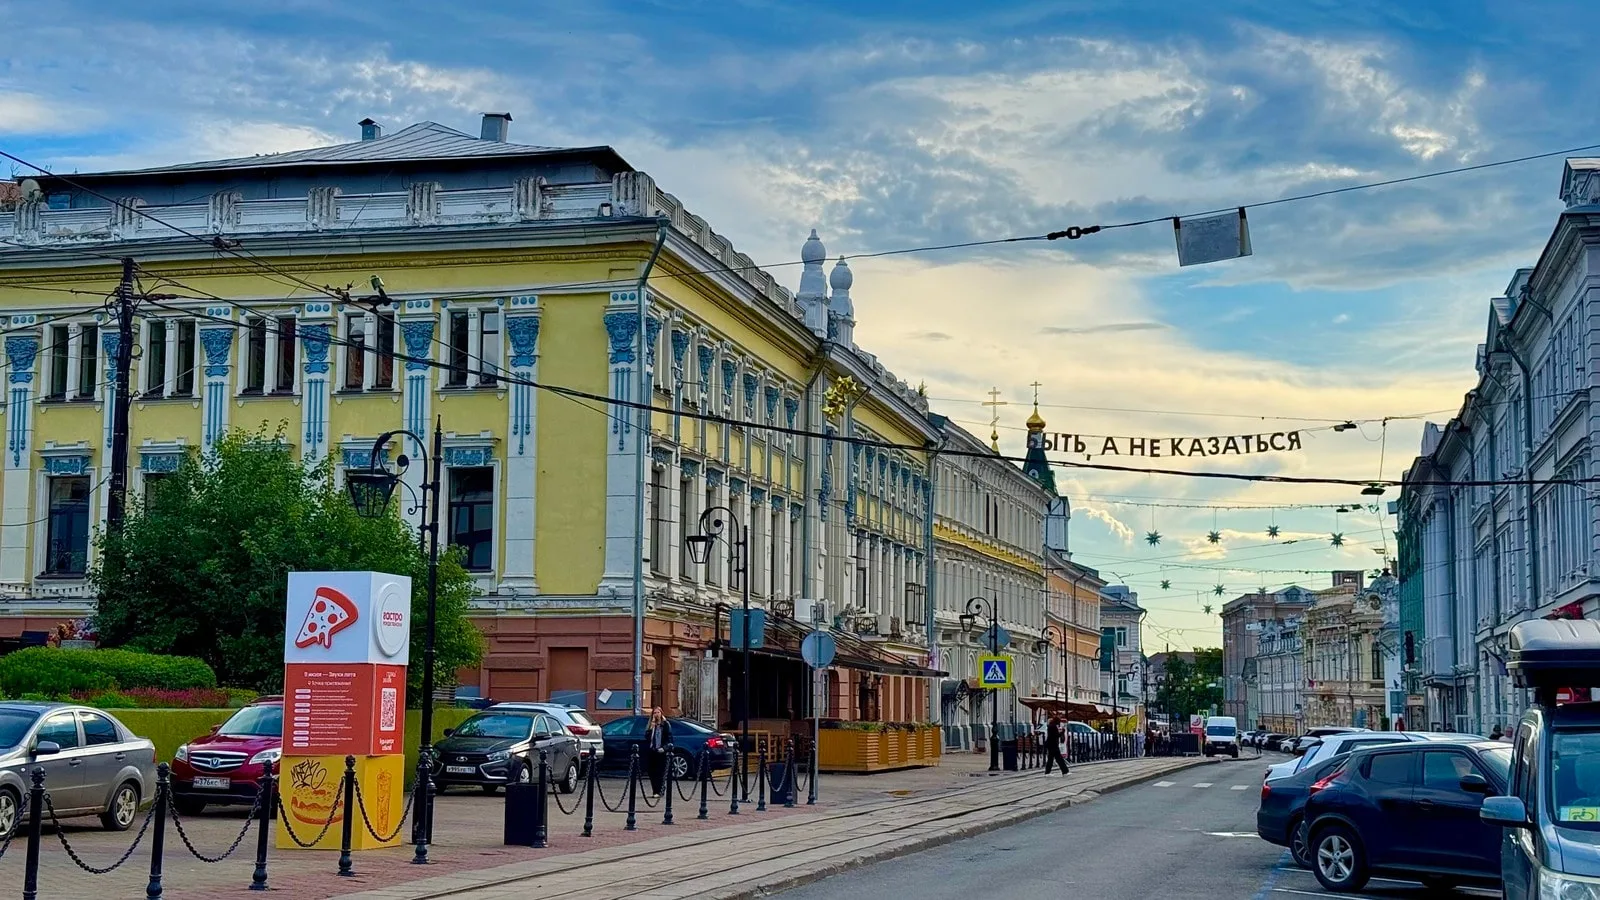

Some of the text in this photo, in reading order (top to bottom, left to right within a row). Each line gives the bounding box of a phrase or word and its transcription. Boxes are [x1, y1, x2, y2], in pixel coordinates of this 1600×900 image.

[1101, 437, 1119, 455] А
[1129, 438, 1160, 457] НЕ
[1170, 431, 1302, 456] КАЗАТЬСЯ
